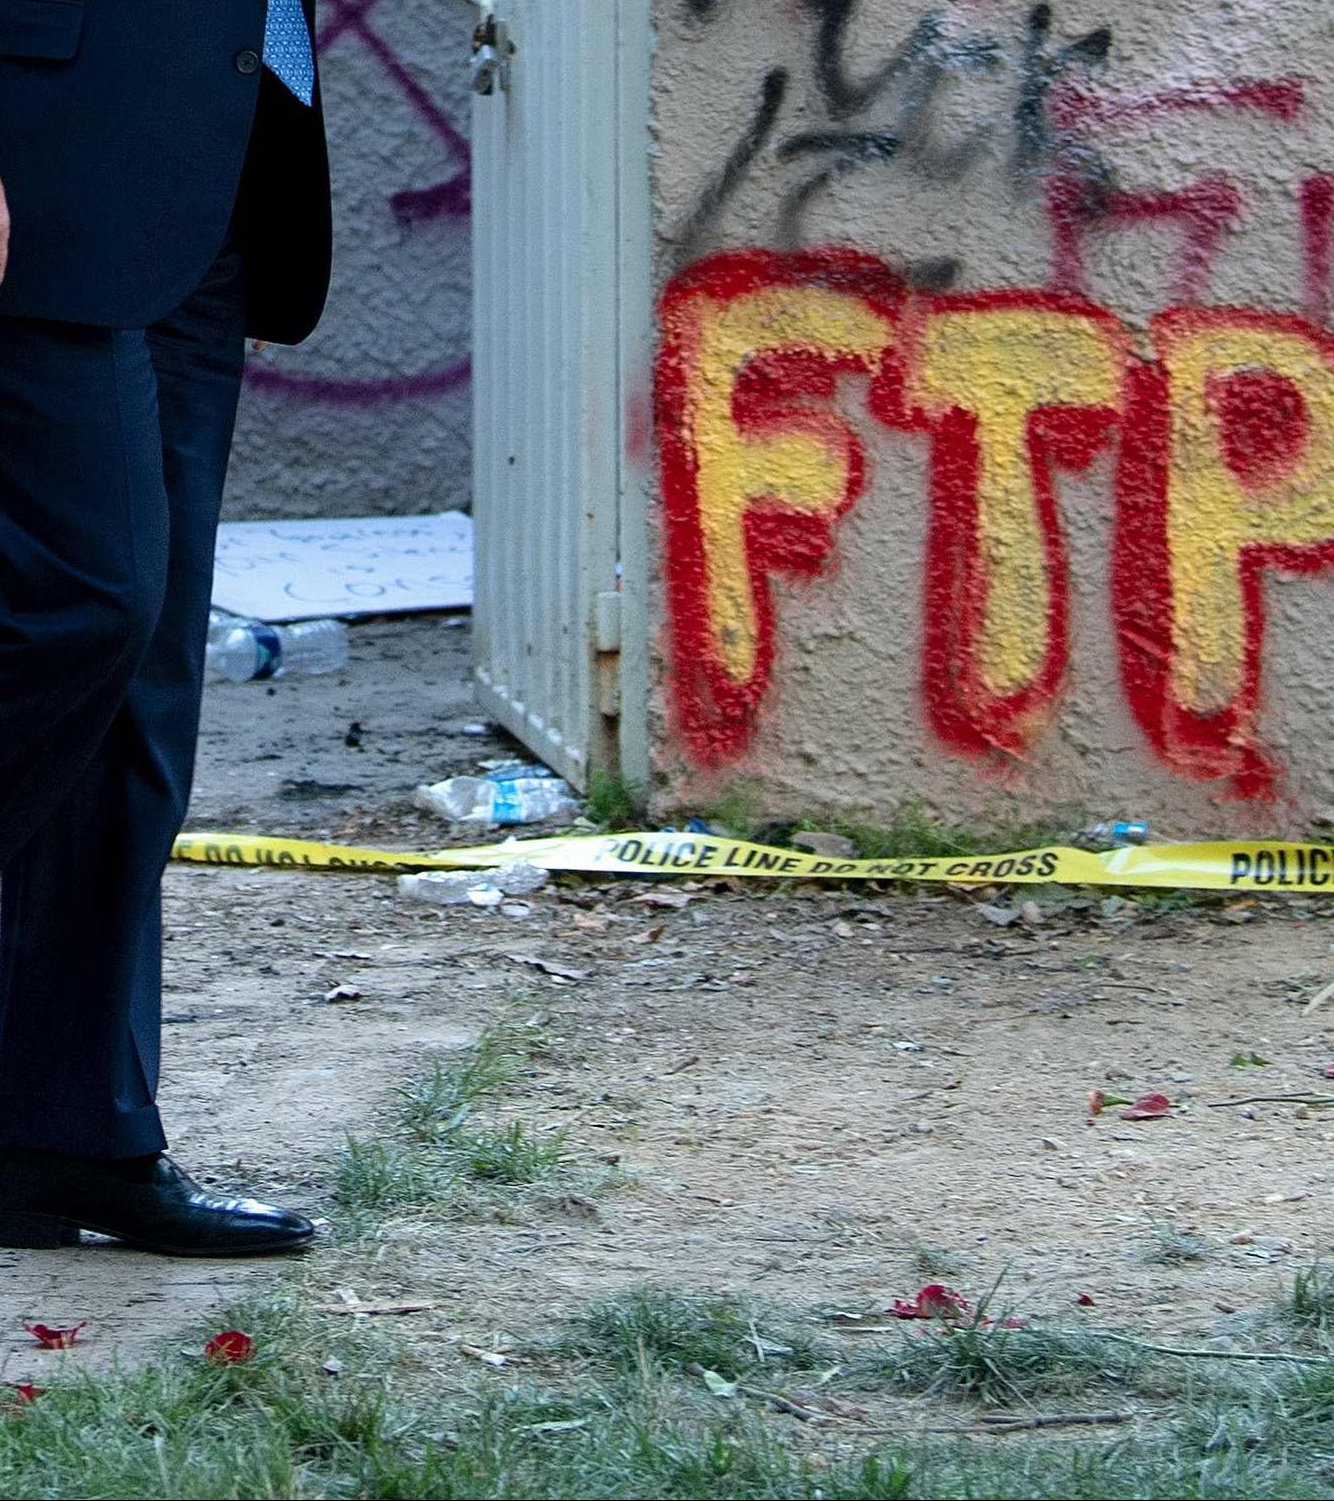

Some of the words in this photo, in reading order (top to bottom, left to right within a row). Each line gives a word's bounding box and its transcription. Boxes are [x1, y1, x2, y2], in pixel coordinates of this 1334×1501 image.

[653, 245, 1334, 805] FTP
[594, 838, 719, 869] POLICE
[724, 845, 801, 874] LINE
[808, 860, 858, 875] DO
[864, 862, 937, 876] NOT
[944, 850, 1060, 878] CROSS
[1230, 847, 1334, 887] POLIC
